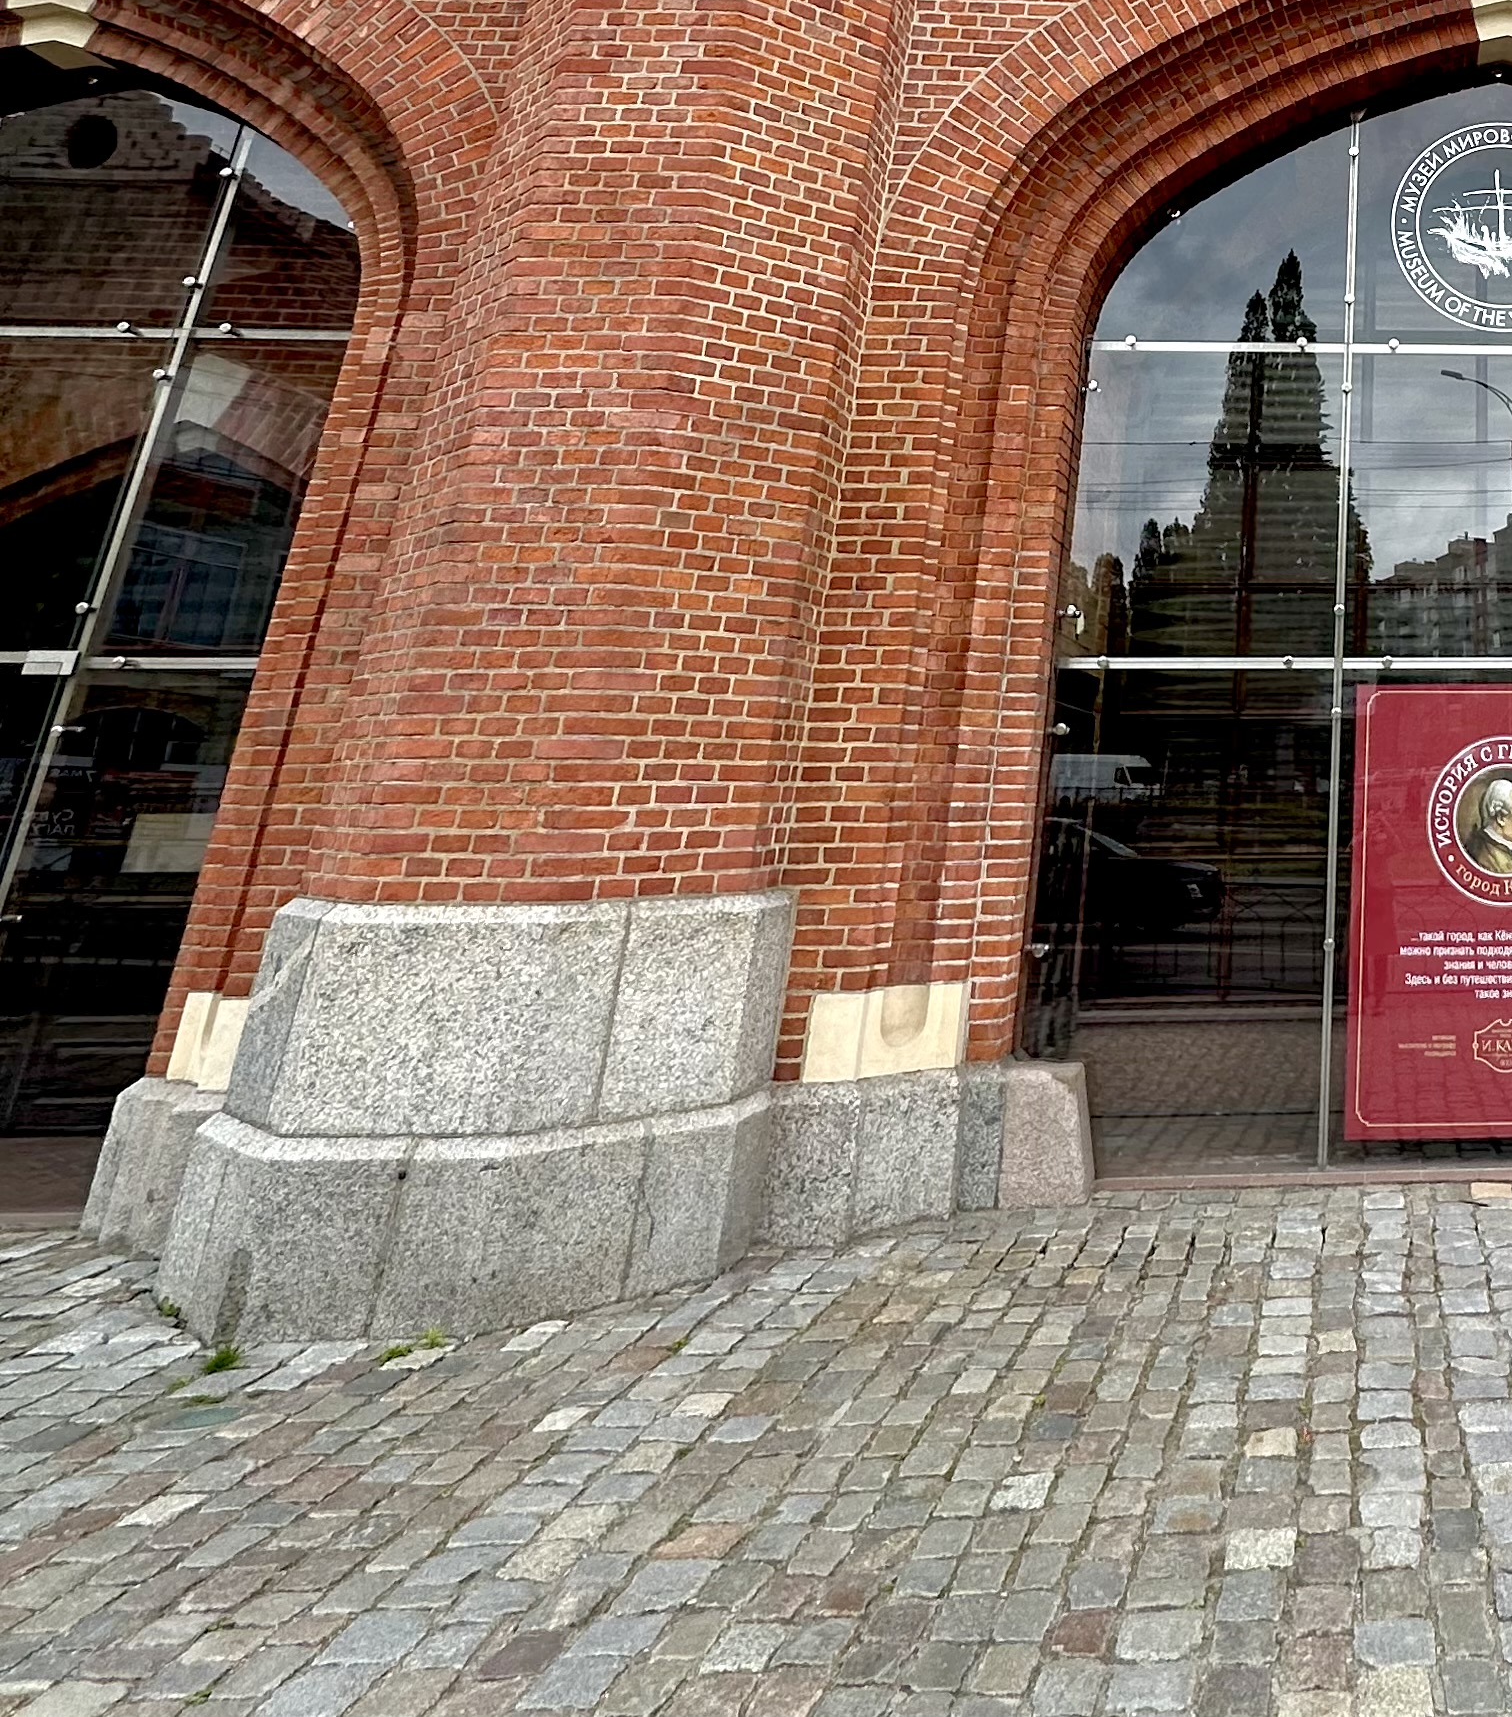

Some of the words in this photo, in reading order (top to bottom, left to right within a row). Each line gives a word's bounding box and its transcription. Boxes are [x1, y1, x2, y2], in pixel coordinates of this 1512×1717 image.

[1400, 150, 1444, 213] МУЗЕЙ
[1398, 231, 1446, 304] MUSEUM
[1444, 296, 1471, 317] OF
[1473, 308, 1505, 326] THE
[1434, 753, 1479, 849] ИСТОРИЯ
[1480, 746, 1493, 762] С
[1455, 864, 1501, 896] город
[1400, 945, 1431, 956] можно
[1477, 960, 1484, 970] и
[1405, 973, 1432, 986] Здесь
[1434, 975, 1440, 984] и
[1442, 973, 1458, 985] без
[1474, 989, 1500, 999] такое
